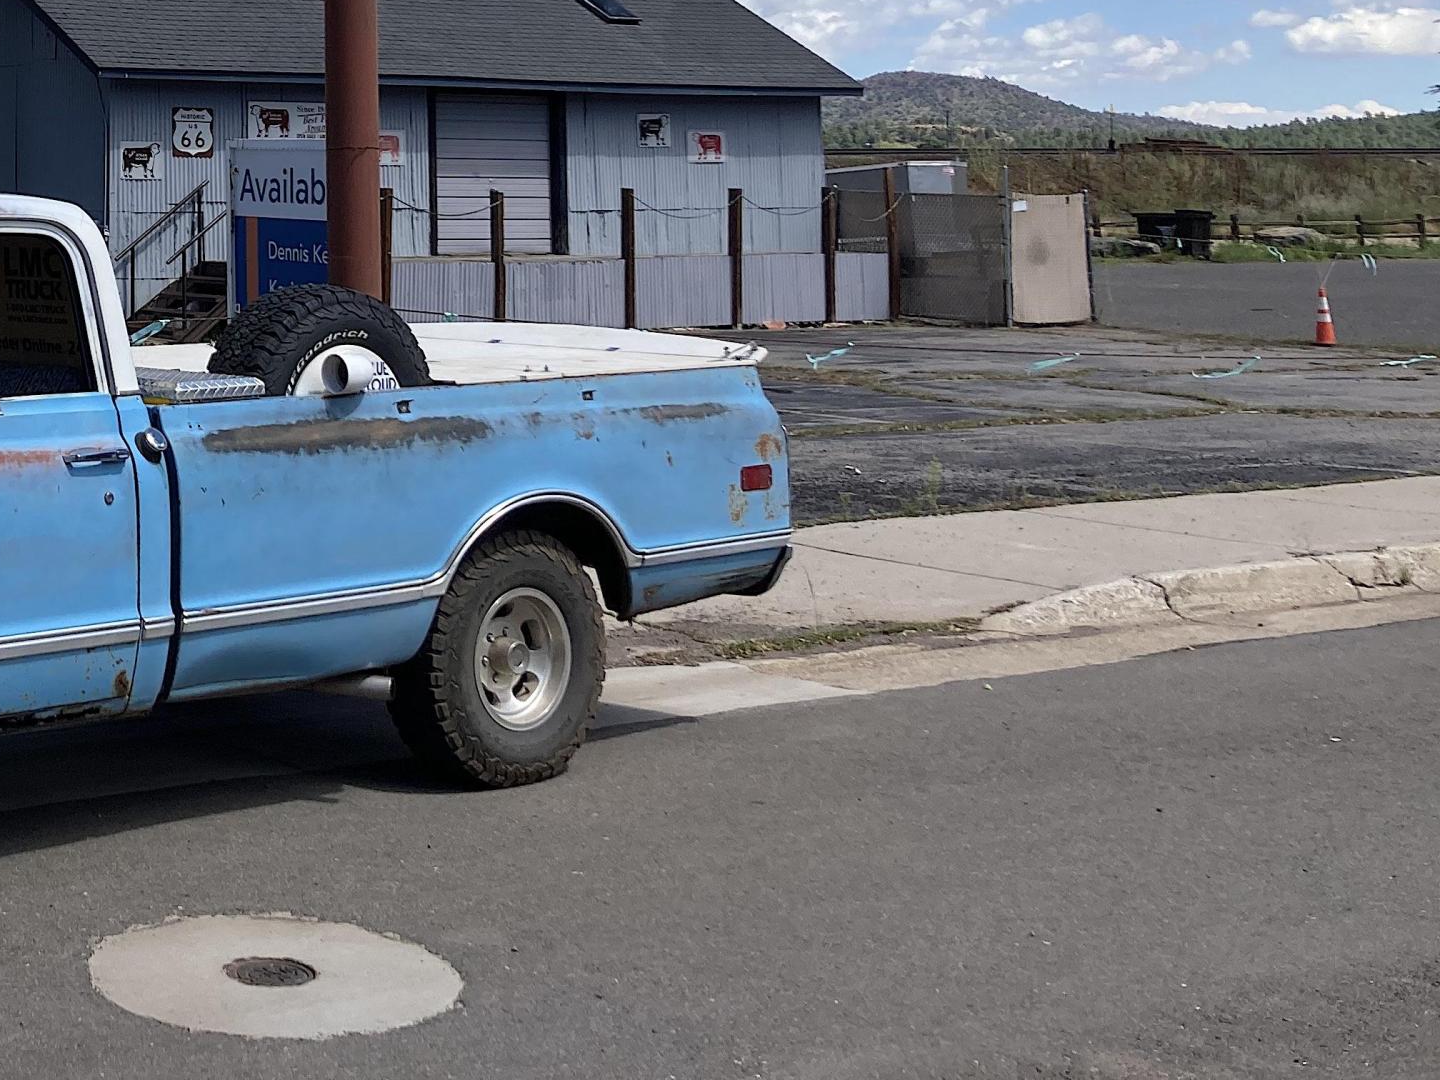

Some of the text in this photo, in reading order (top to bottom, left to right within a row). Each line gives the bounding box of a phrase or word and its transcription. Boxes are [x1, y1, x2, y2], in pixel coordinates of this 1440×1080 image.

[181, 130, 205, 148] 66
[240, 167, 326, 205] Availab
[268, 240, 309, 263] Dennis
